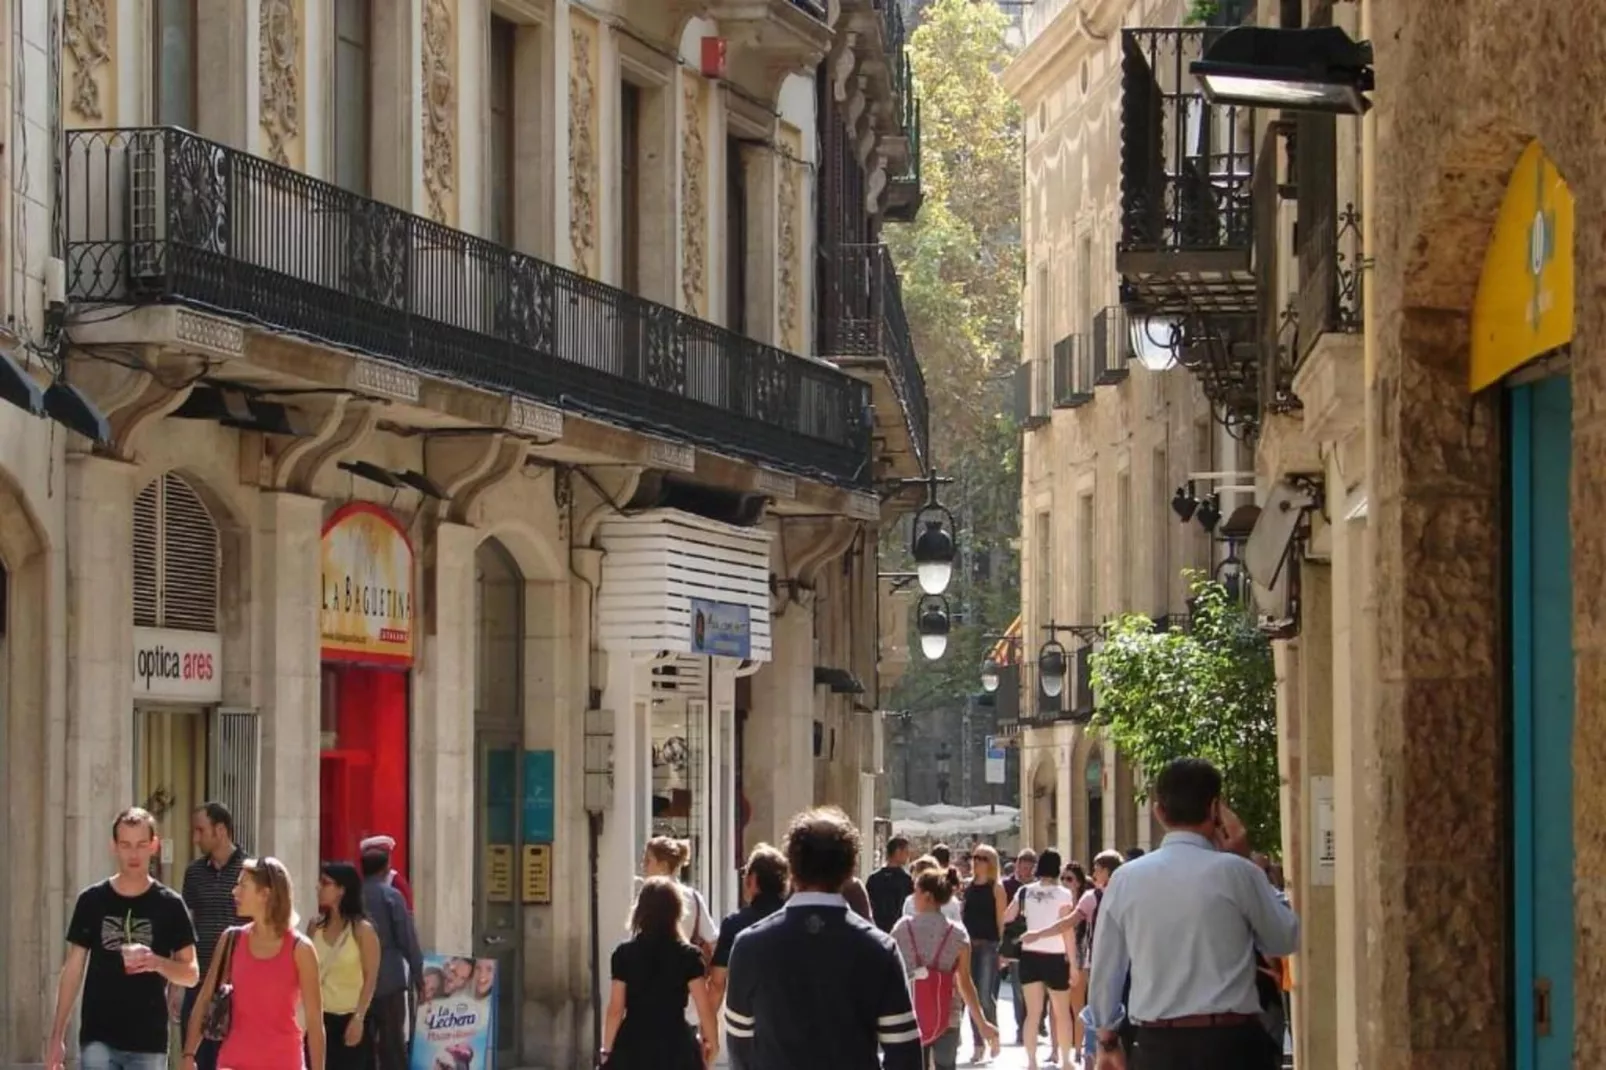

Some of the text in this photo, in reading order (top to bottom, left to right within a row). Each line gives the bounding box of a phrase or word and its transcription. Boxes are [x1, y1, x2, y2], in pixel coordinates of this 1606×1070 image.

[321, 573, 340, 611] LA
[137, 644, 213, 690] optica ares
[428, 1013, 476, 1029] Lechera
[438, 1005, 450, 1017] La
